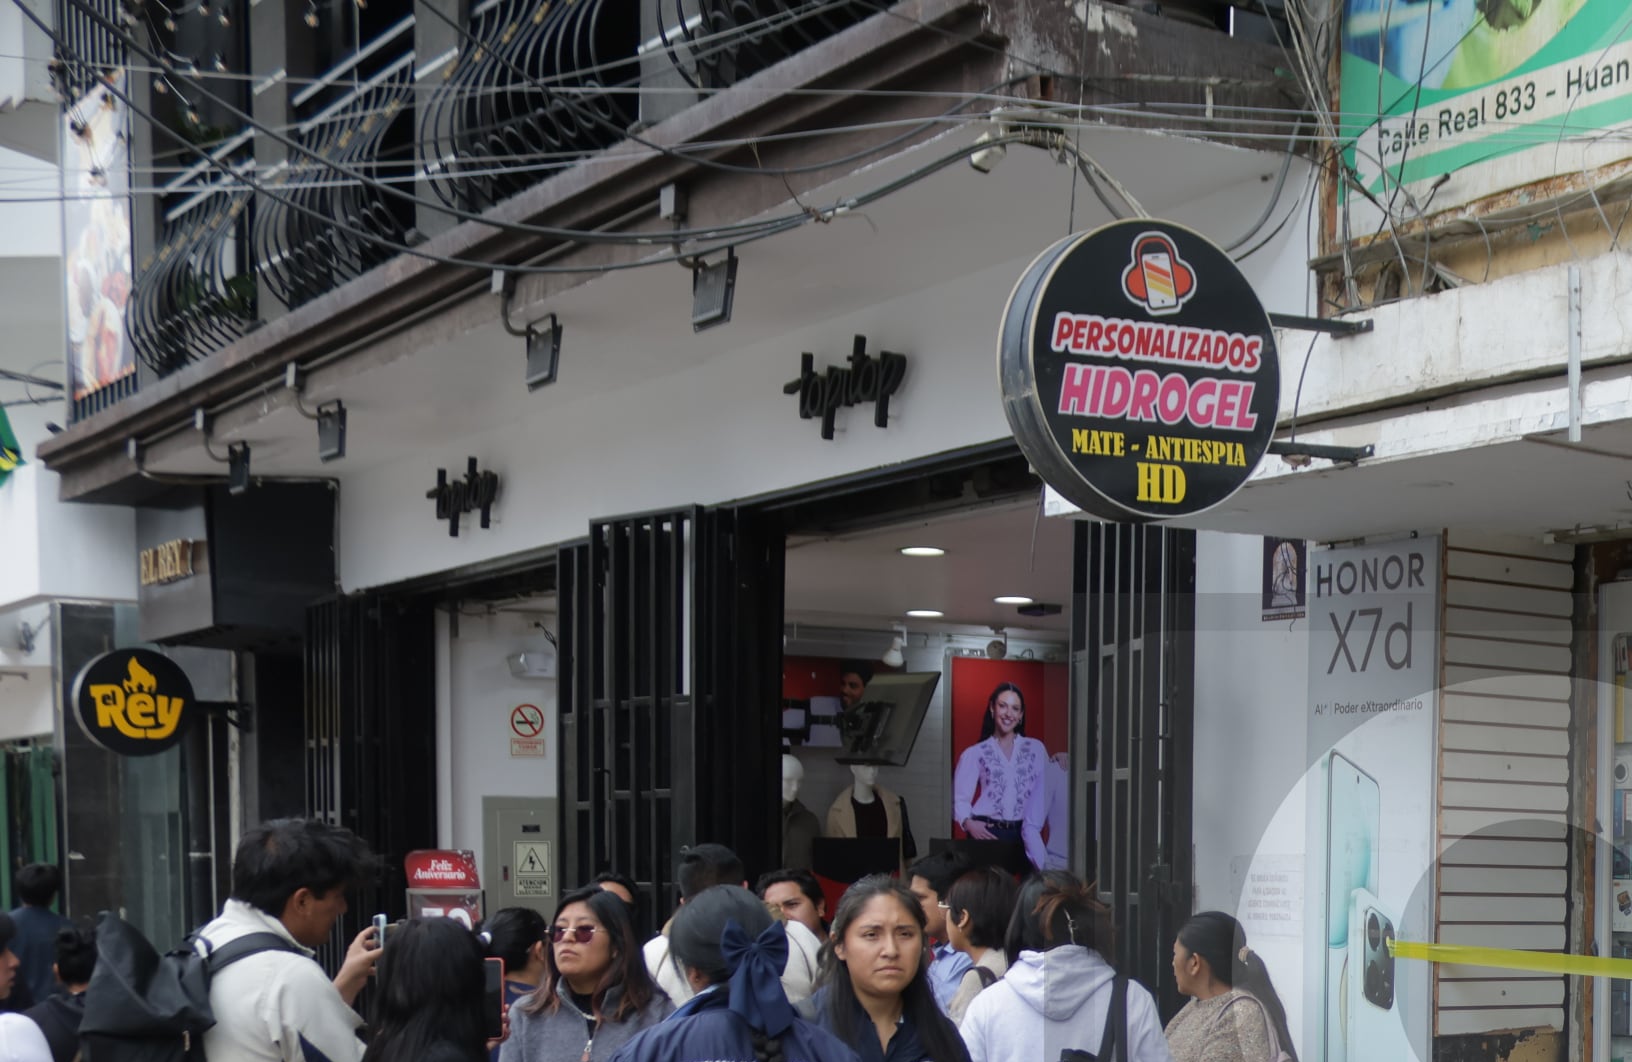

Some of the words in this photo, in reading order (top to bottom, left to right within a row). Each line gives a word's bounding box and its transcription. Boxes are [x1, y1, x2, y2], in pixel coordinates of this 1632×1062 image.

[1438, 97, 1486, 138] Real
[1495, 82, 1536, 119] 833
[1052, 313, 1262, 372] PERSONALIZADOS
[1058, 363, 1258, 431] HIDROGEL
[1071, 428, 1125, 457] MATE
[1145, 435, 1247, 466] ANTIESPIA
[1136, 461, 1186, 504] HD
[1316, 552, 1425, 598] HONOR
[1326, 601, 1413, 675] X7d
[1334, 702, 1359, 714] Poder
[1360, 698, 1423, 713] eXtraordinario
[414, 867, 467, 880] Aniversario
[430, 858, 453, 872] Feliz
